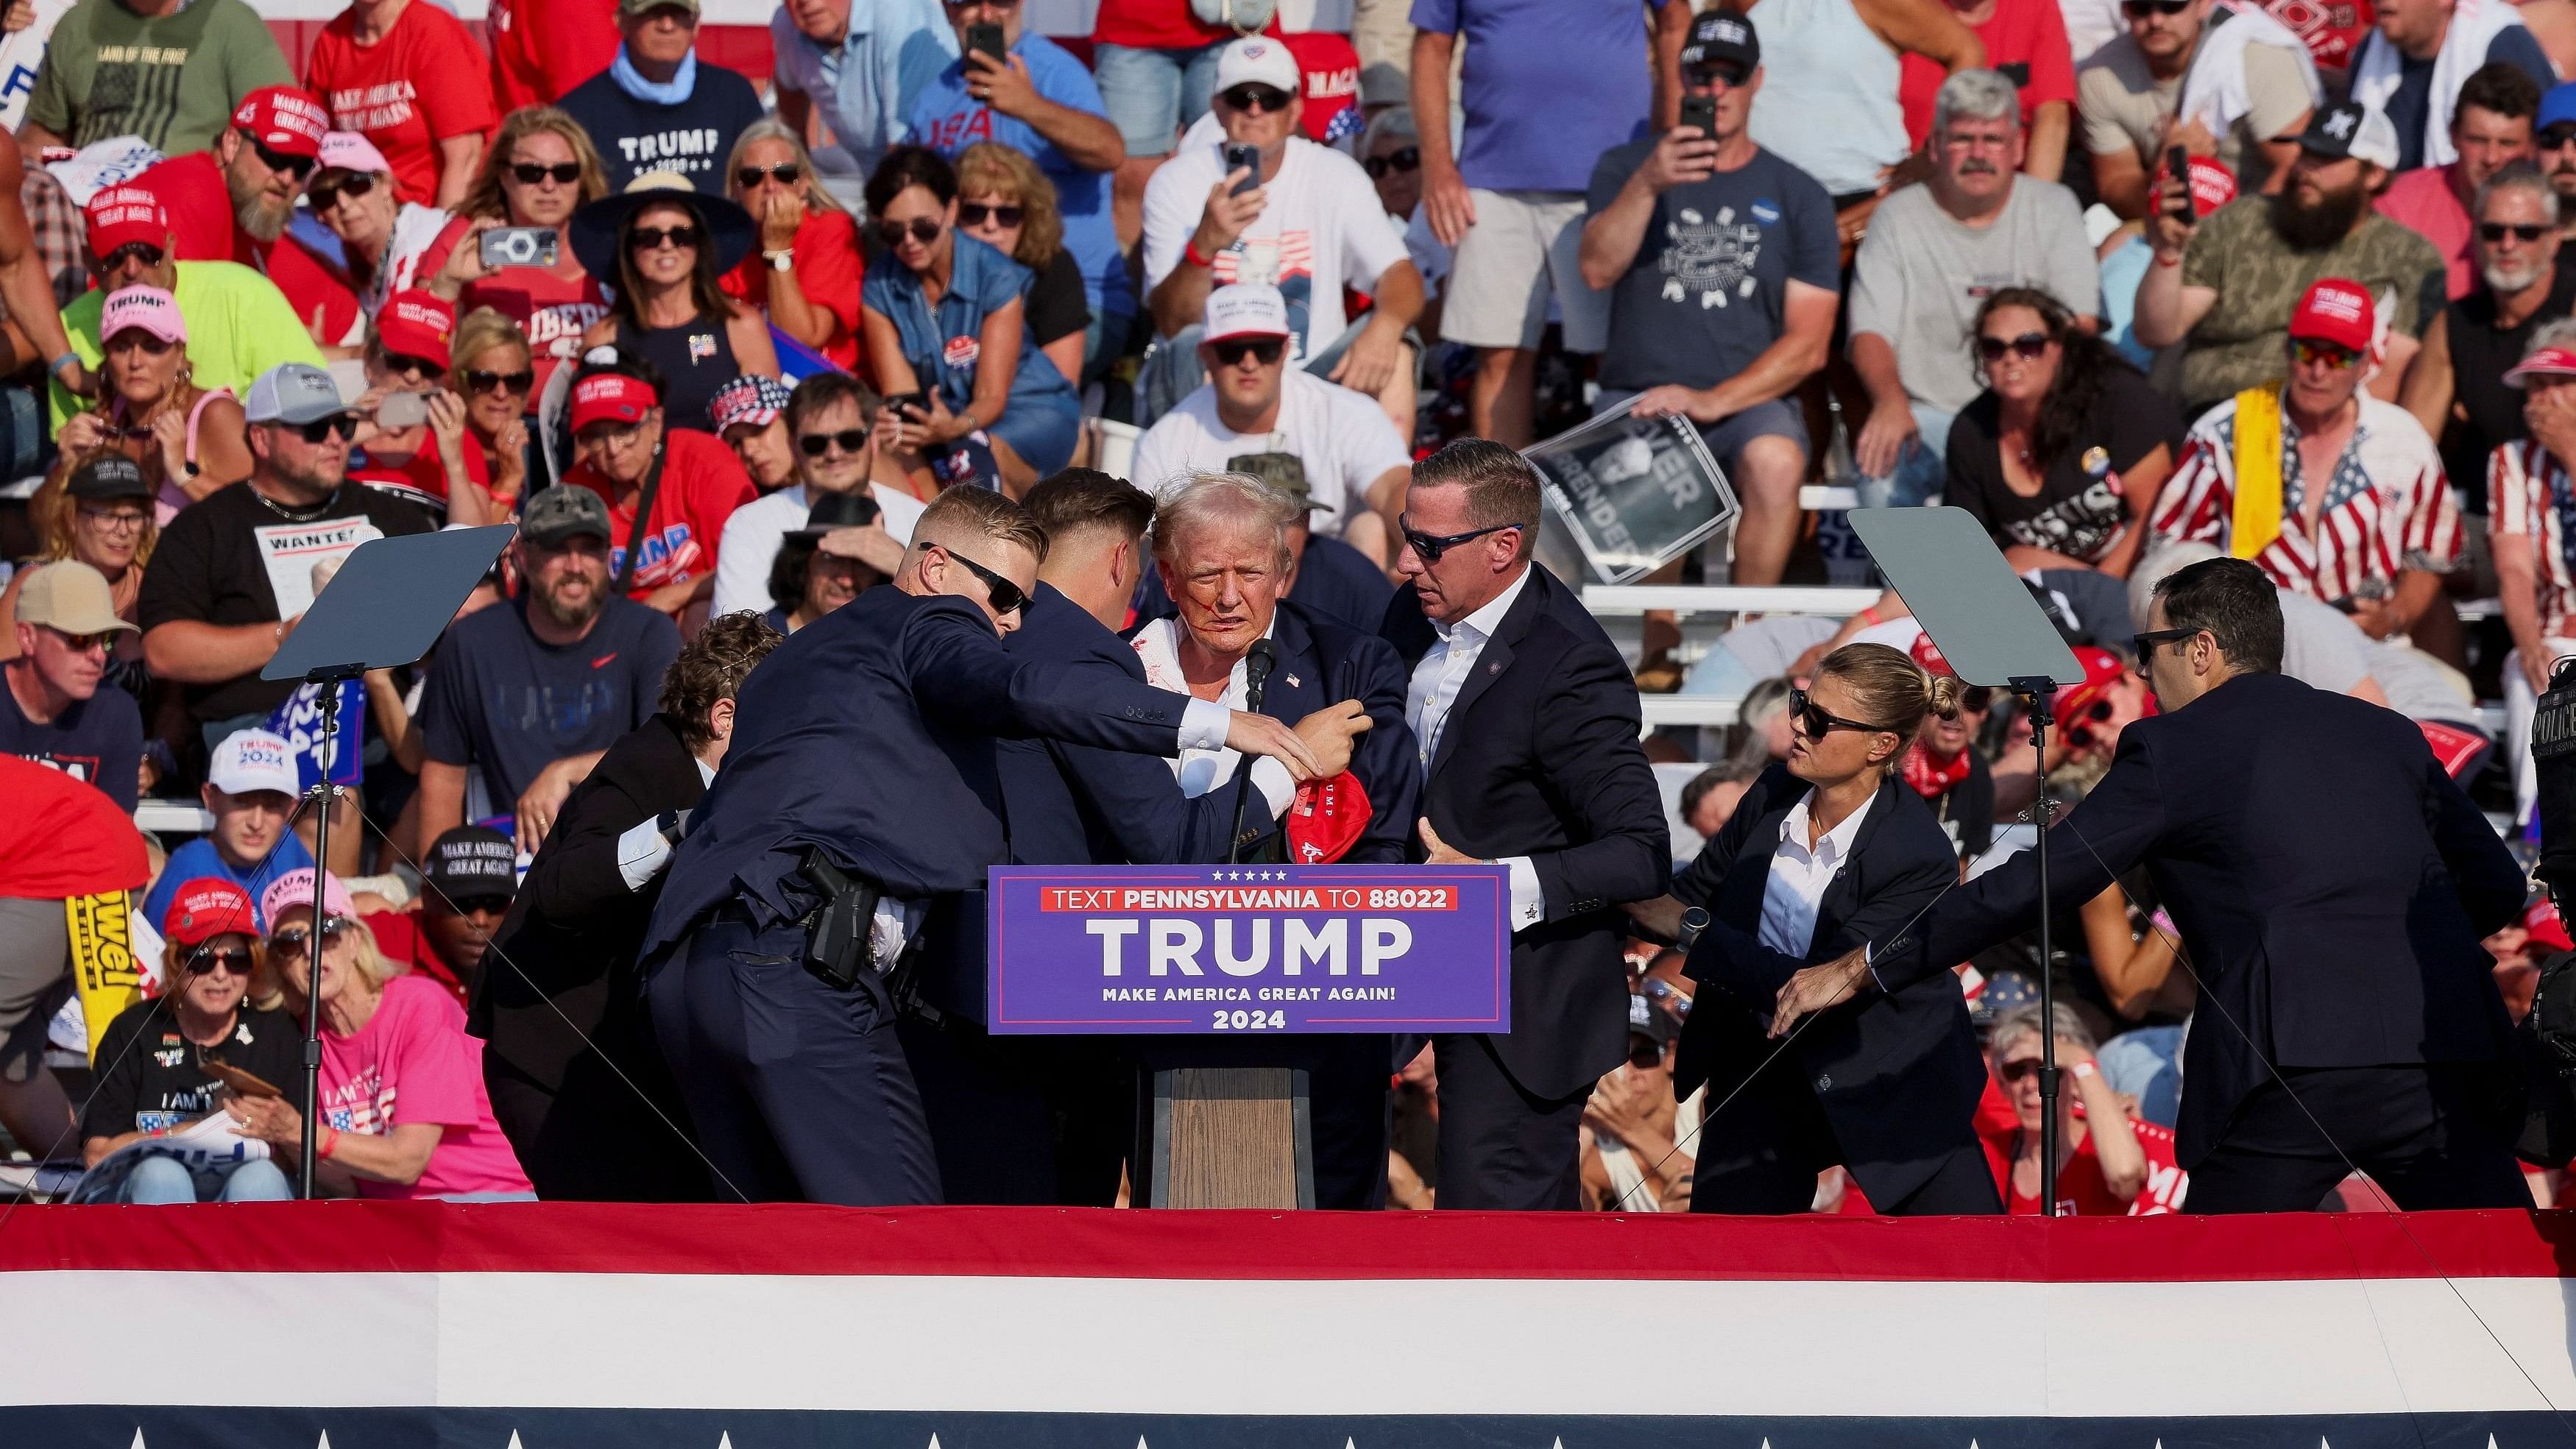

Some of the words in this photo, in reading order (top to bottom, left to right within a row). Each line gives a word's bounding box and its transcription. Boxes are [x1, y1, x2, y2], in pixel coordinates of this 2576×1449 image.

[618, 129, 719, 161] TRUMP
[110, 294, 166, 312] TRUMP
[2533, 703, 2576, 746] POLICE
[238, 740, 283, 752] TRUMP
[239, 751, 283, 766] 2024
[1326, 784, 1334, 816] UMP
[442, 841, 473, 860] MAKE
[473, 841, 514, 860] AMERICA
[447, 859, 483, 876] GREAT
[483, 858, 512, 876] AGAIN
[267, 875, 314, 904] TRUM
[1052, 890, 1117, 909] TEXT
[1124, 890, 1320, 909] PENNSYLVANIA
[1328, 890, 1361, 908] TO
[1369, 890, 1447, 908] 88022
[1086, 918, 1412, 977] TRUMP
[1103, 988, 1156, 1002] MAKE
[1163, 988, 1250, 1001] AMERICA
[1258, 988, 1321, 1001] GREAT
[1328, 988, 1395, 1001] AGAIN!
[1213, 1010, 1286, 1030] 2024
[161, 1092, 168, 1109] I
[171, 1091, 197, 1110] AM
